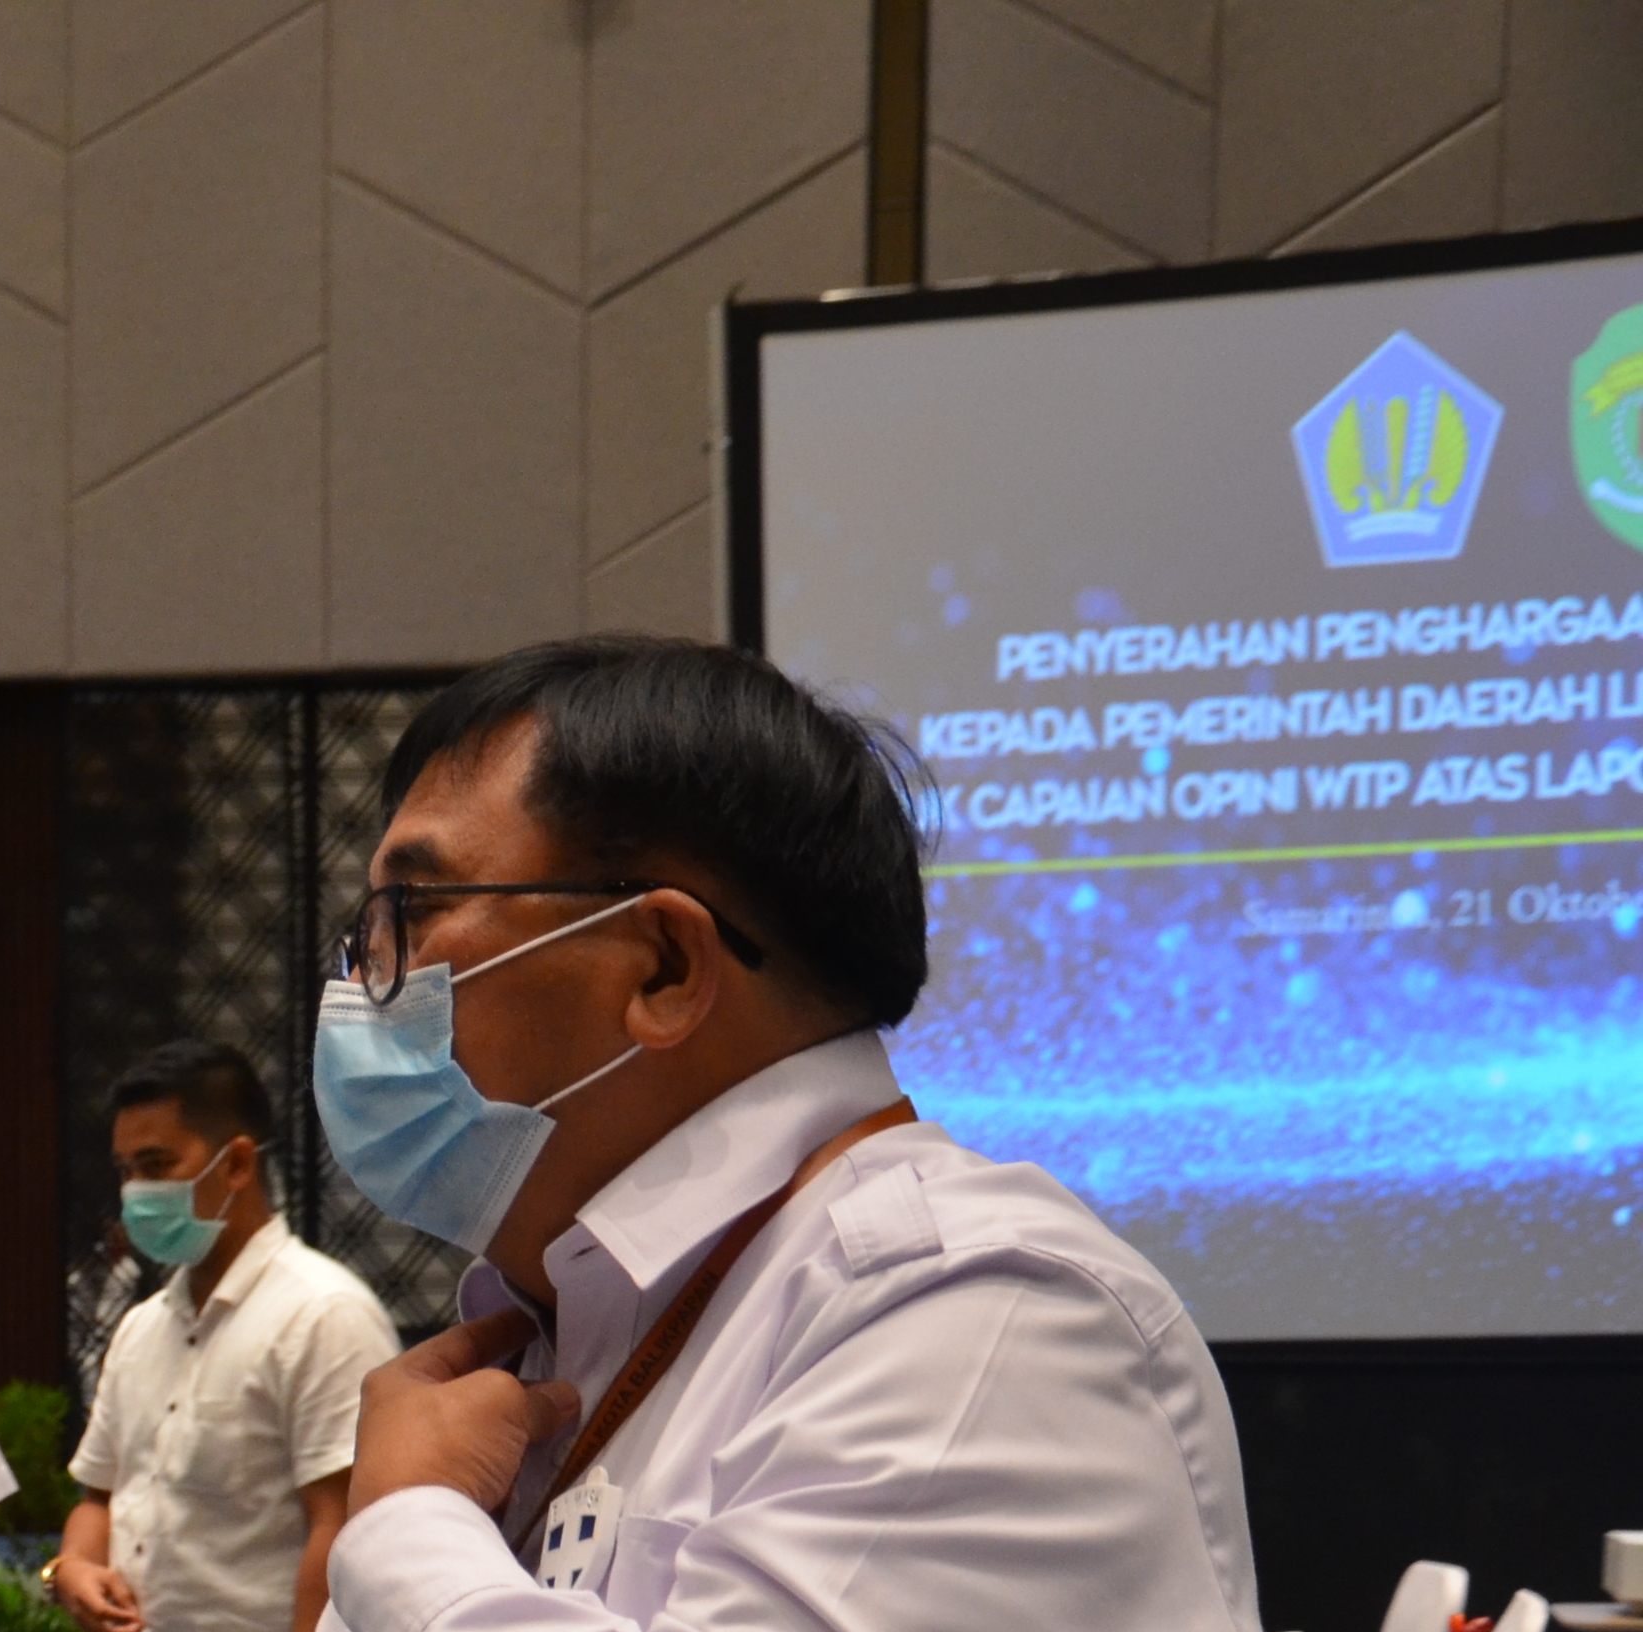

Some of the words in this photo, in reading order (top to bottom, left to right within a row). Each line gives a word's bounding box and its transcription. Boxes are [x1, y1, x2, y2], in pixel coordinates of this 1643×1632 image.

[997, 616, 1310, 681] PENYERAHAN
[919, 706, 1098, 757] KEPADA
[1102, 686, 1394, 748] PEMERINTAH
[1398, 672, 1602, 732] DAERAH
[968, 774, 1167, 828] CAPAIAN
[1172, 766, 1300, 819] OPINI
[1302, 760, 1411, 810] WTP
[1409, 755, 1531, 806] ATAS
[1449, 889, 1494, 926] 21
